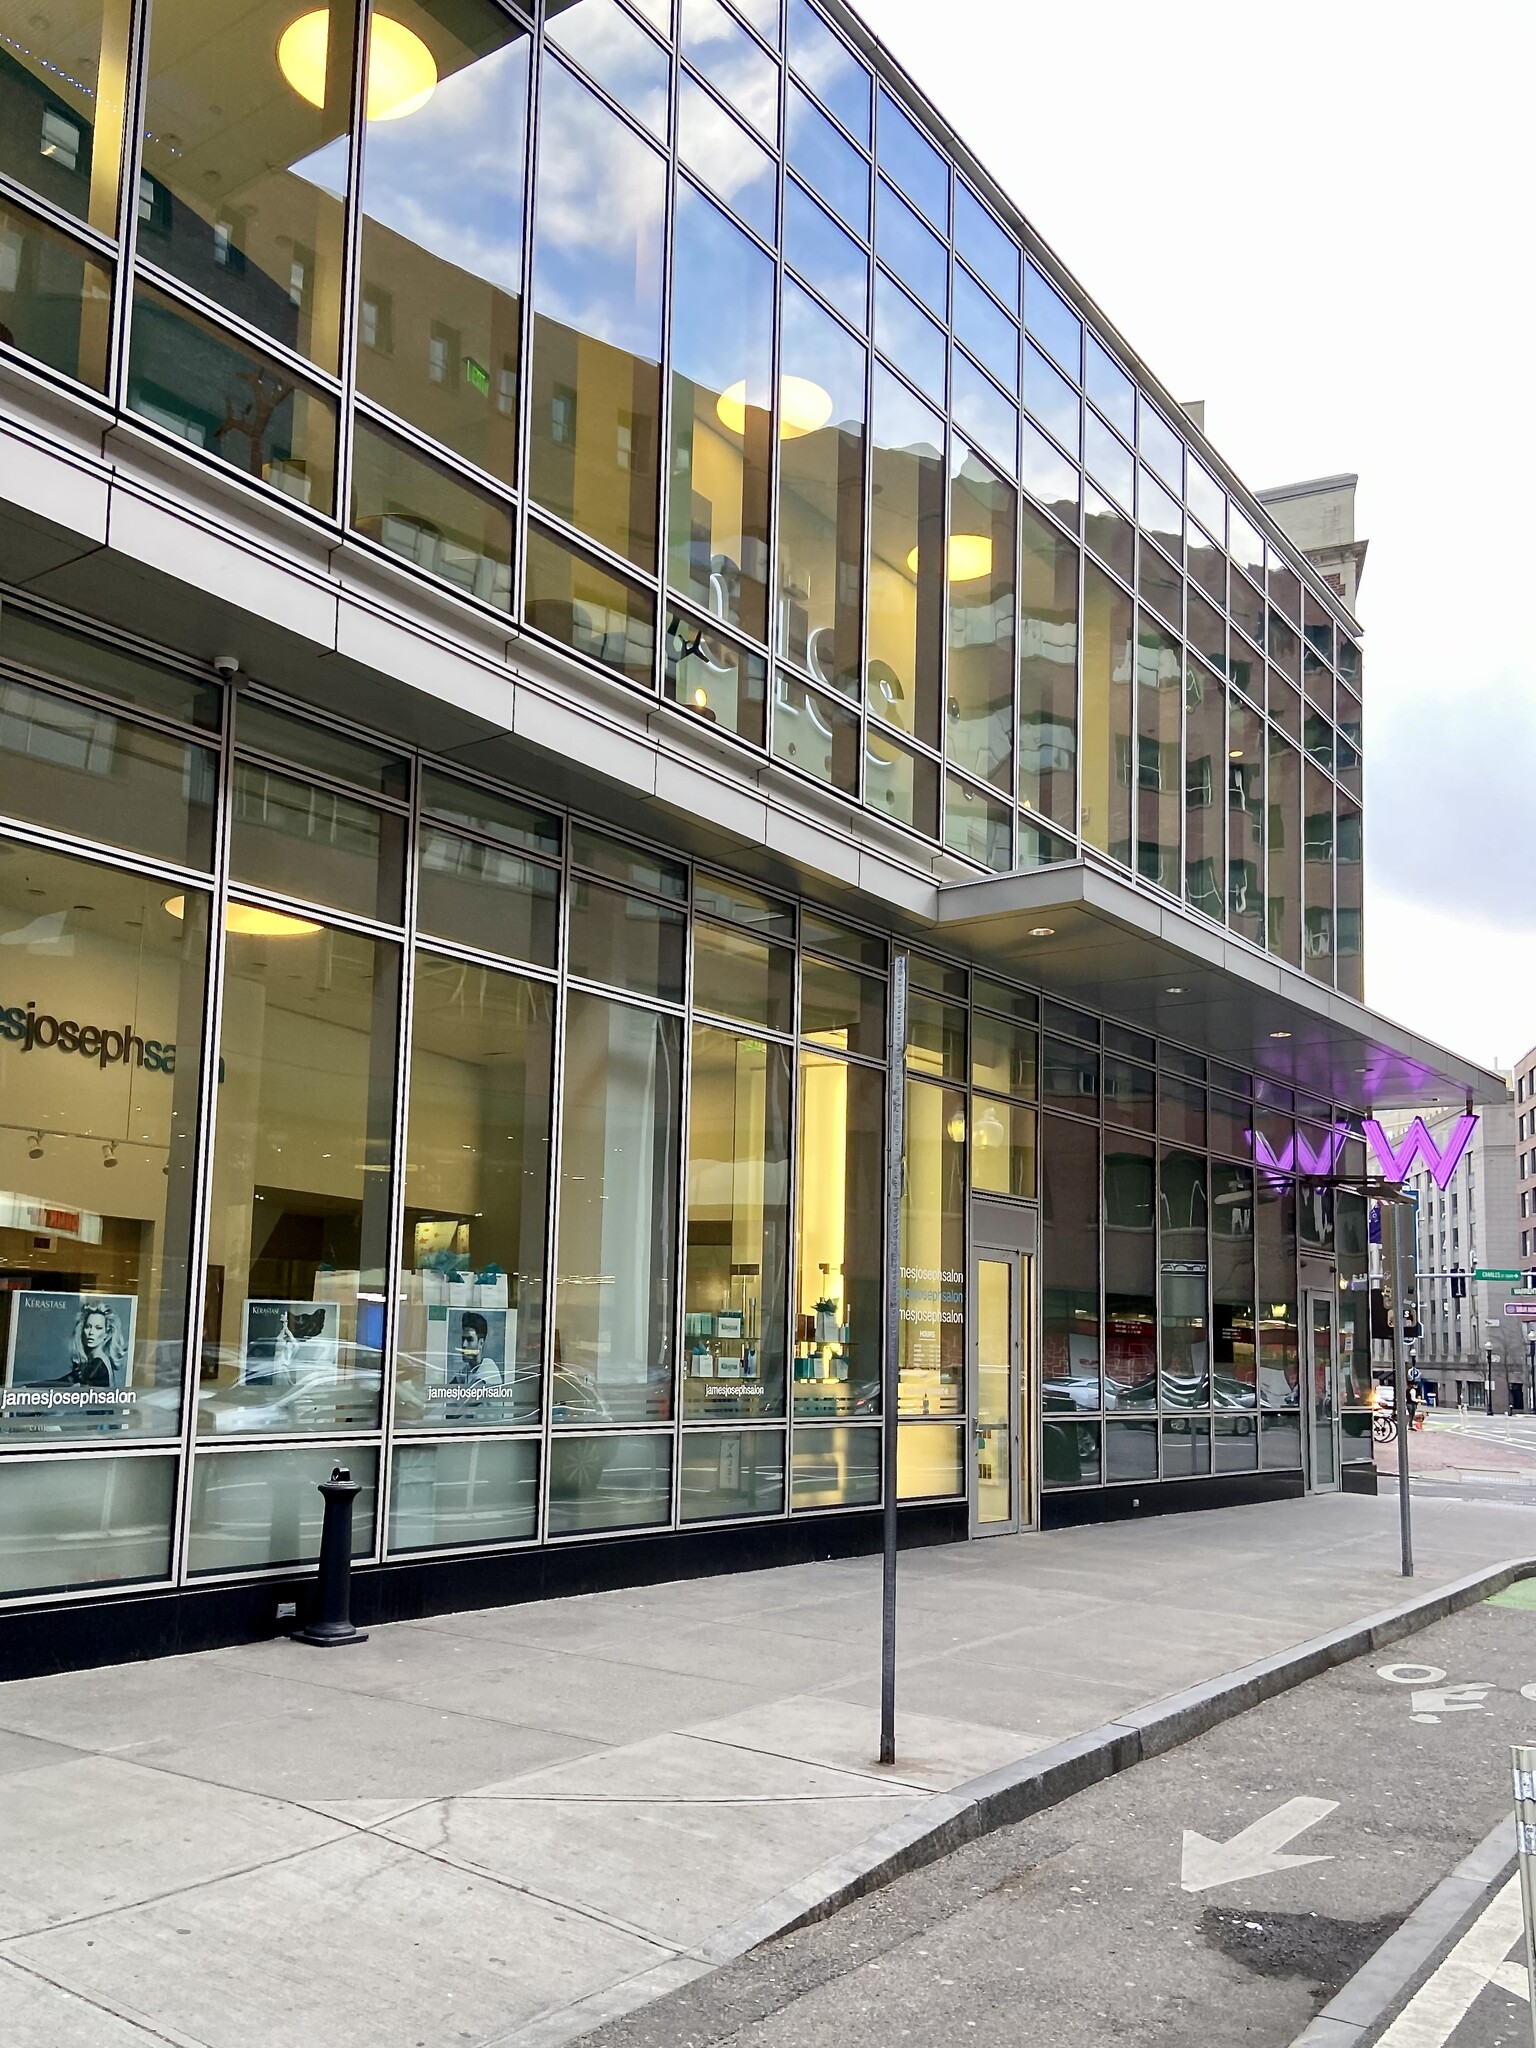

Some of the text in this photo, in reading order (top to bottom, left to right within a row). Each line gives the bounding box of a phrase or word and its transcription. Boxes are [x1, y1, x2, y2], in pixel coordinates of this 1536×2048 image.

[1361, 1115, 1480, 1191] W
[1, 1389, 136, 1409] jamesjosephsalon
[428, 1386, 512, 1400] jamesjosephsalon
[705, 1385, 764, 1397] jamesjosephsalon
